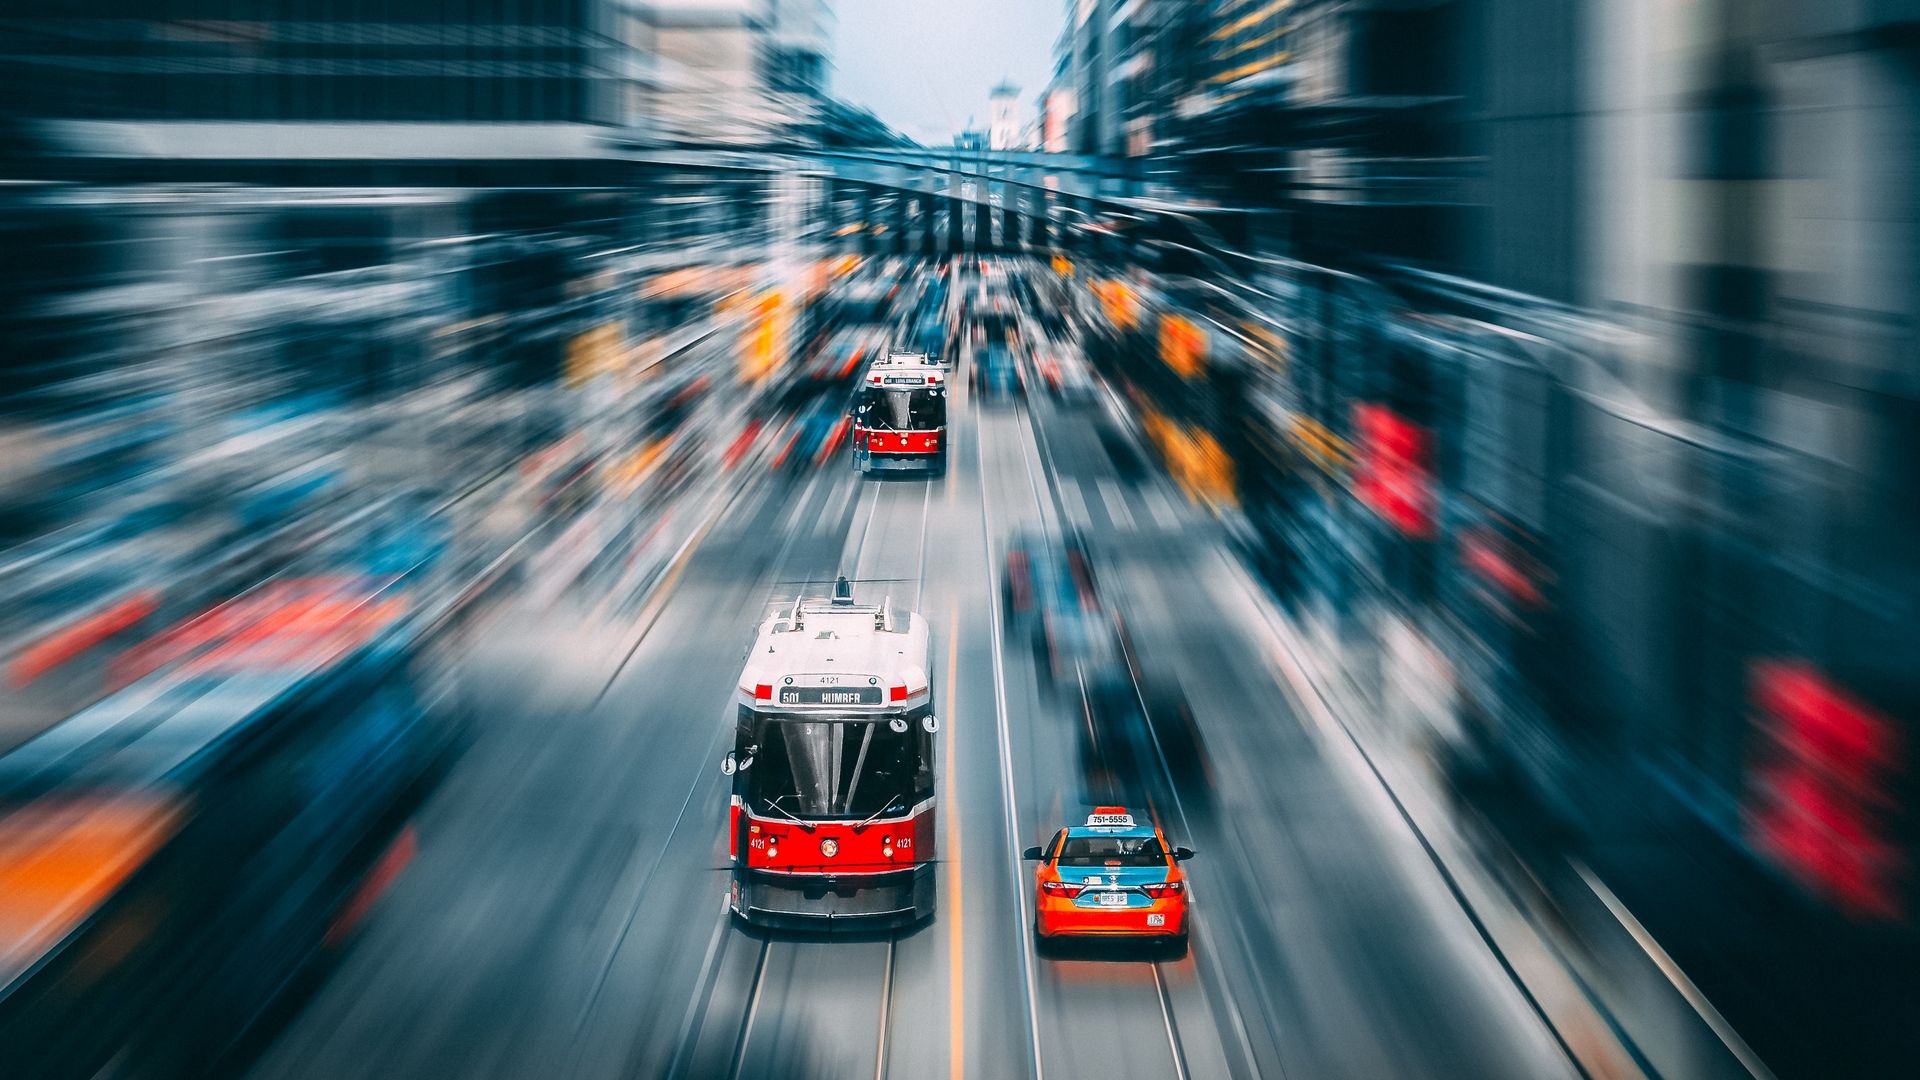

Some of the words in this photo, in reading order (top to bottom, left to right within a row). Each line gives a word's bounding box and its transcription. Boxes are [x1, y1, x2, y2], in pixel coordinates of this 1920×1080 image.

[783, 692, 799, 703] 501
[751, 838, 765, 849] 4121
[897, 838, 911, 848] 4121
